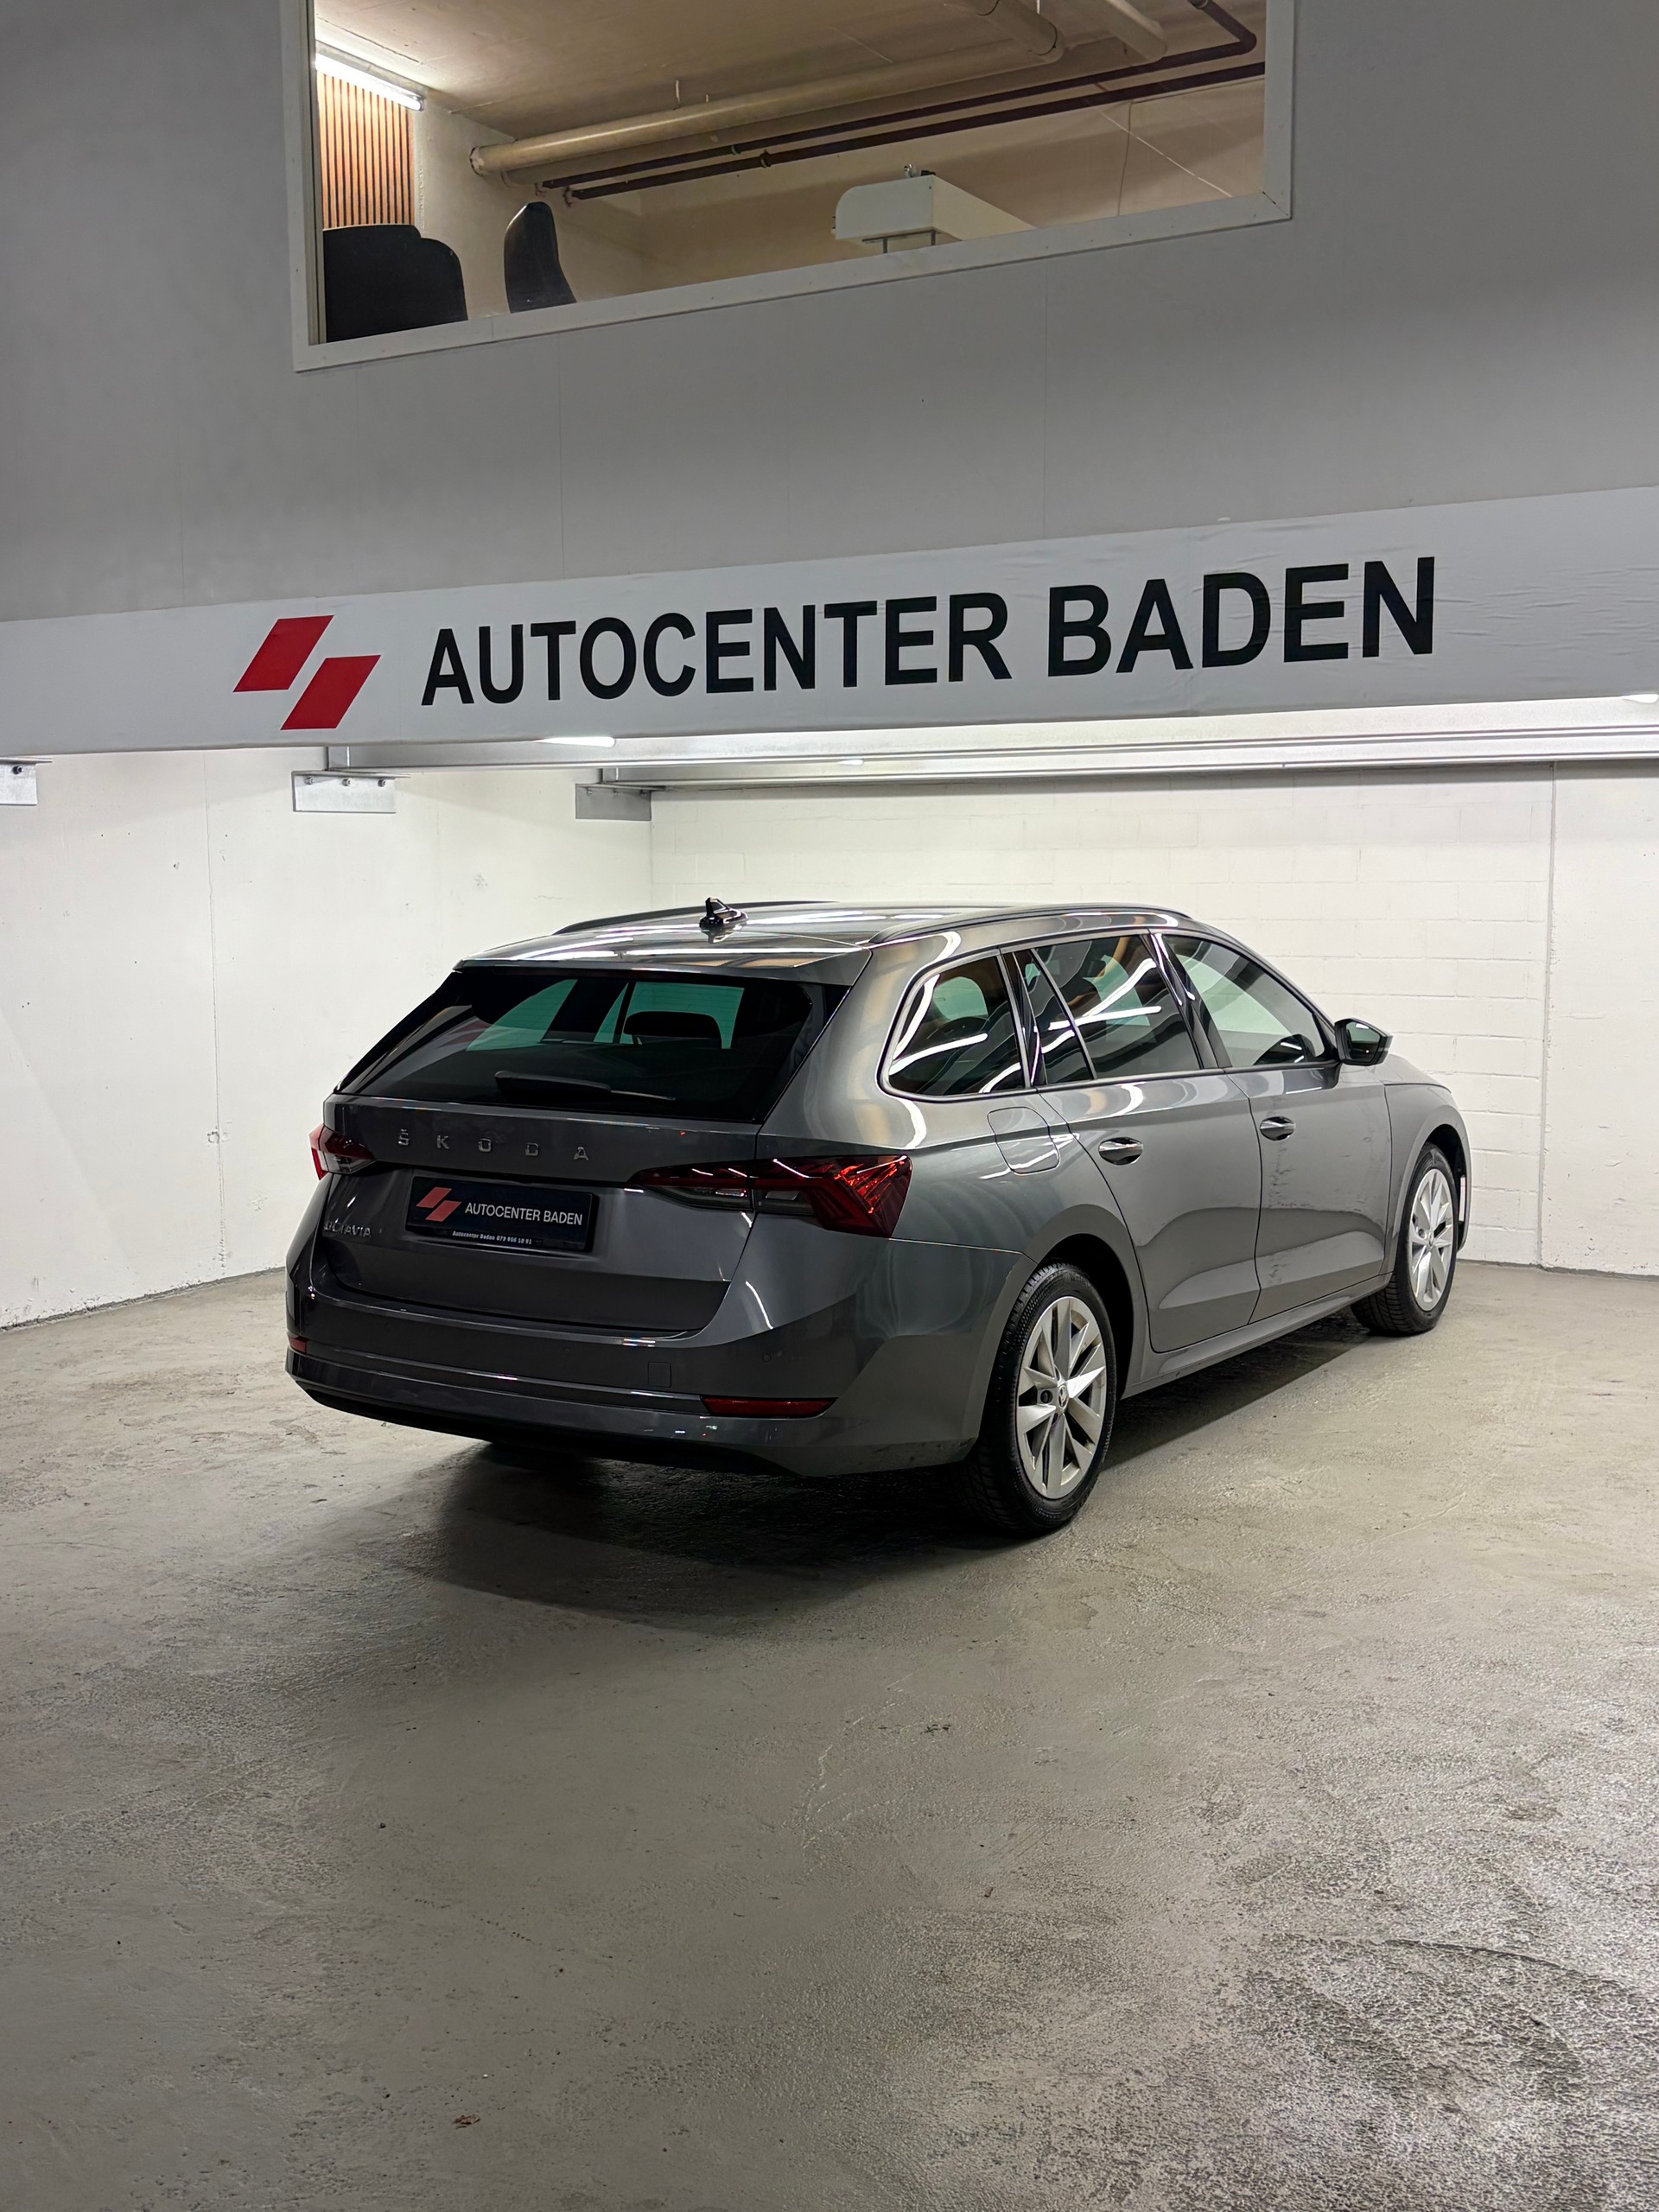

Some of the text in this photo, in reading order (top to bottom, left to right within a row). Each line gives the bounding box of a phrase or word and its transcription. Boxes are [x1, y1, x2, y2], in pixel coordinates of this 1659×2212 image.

[421, 556, 1435, 706] AUTOCENTER BADEN
[465, 1203, 582, 1226] AUTOCENTER BADEN
